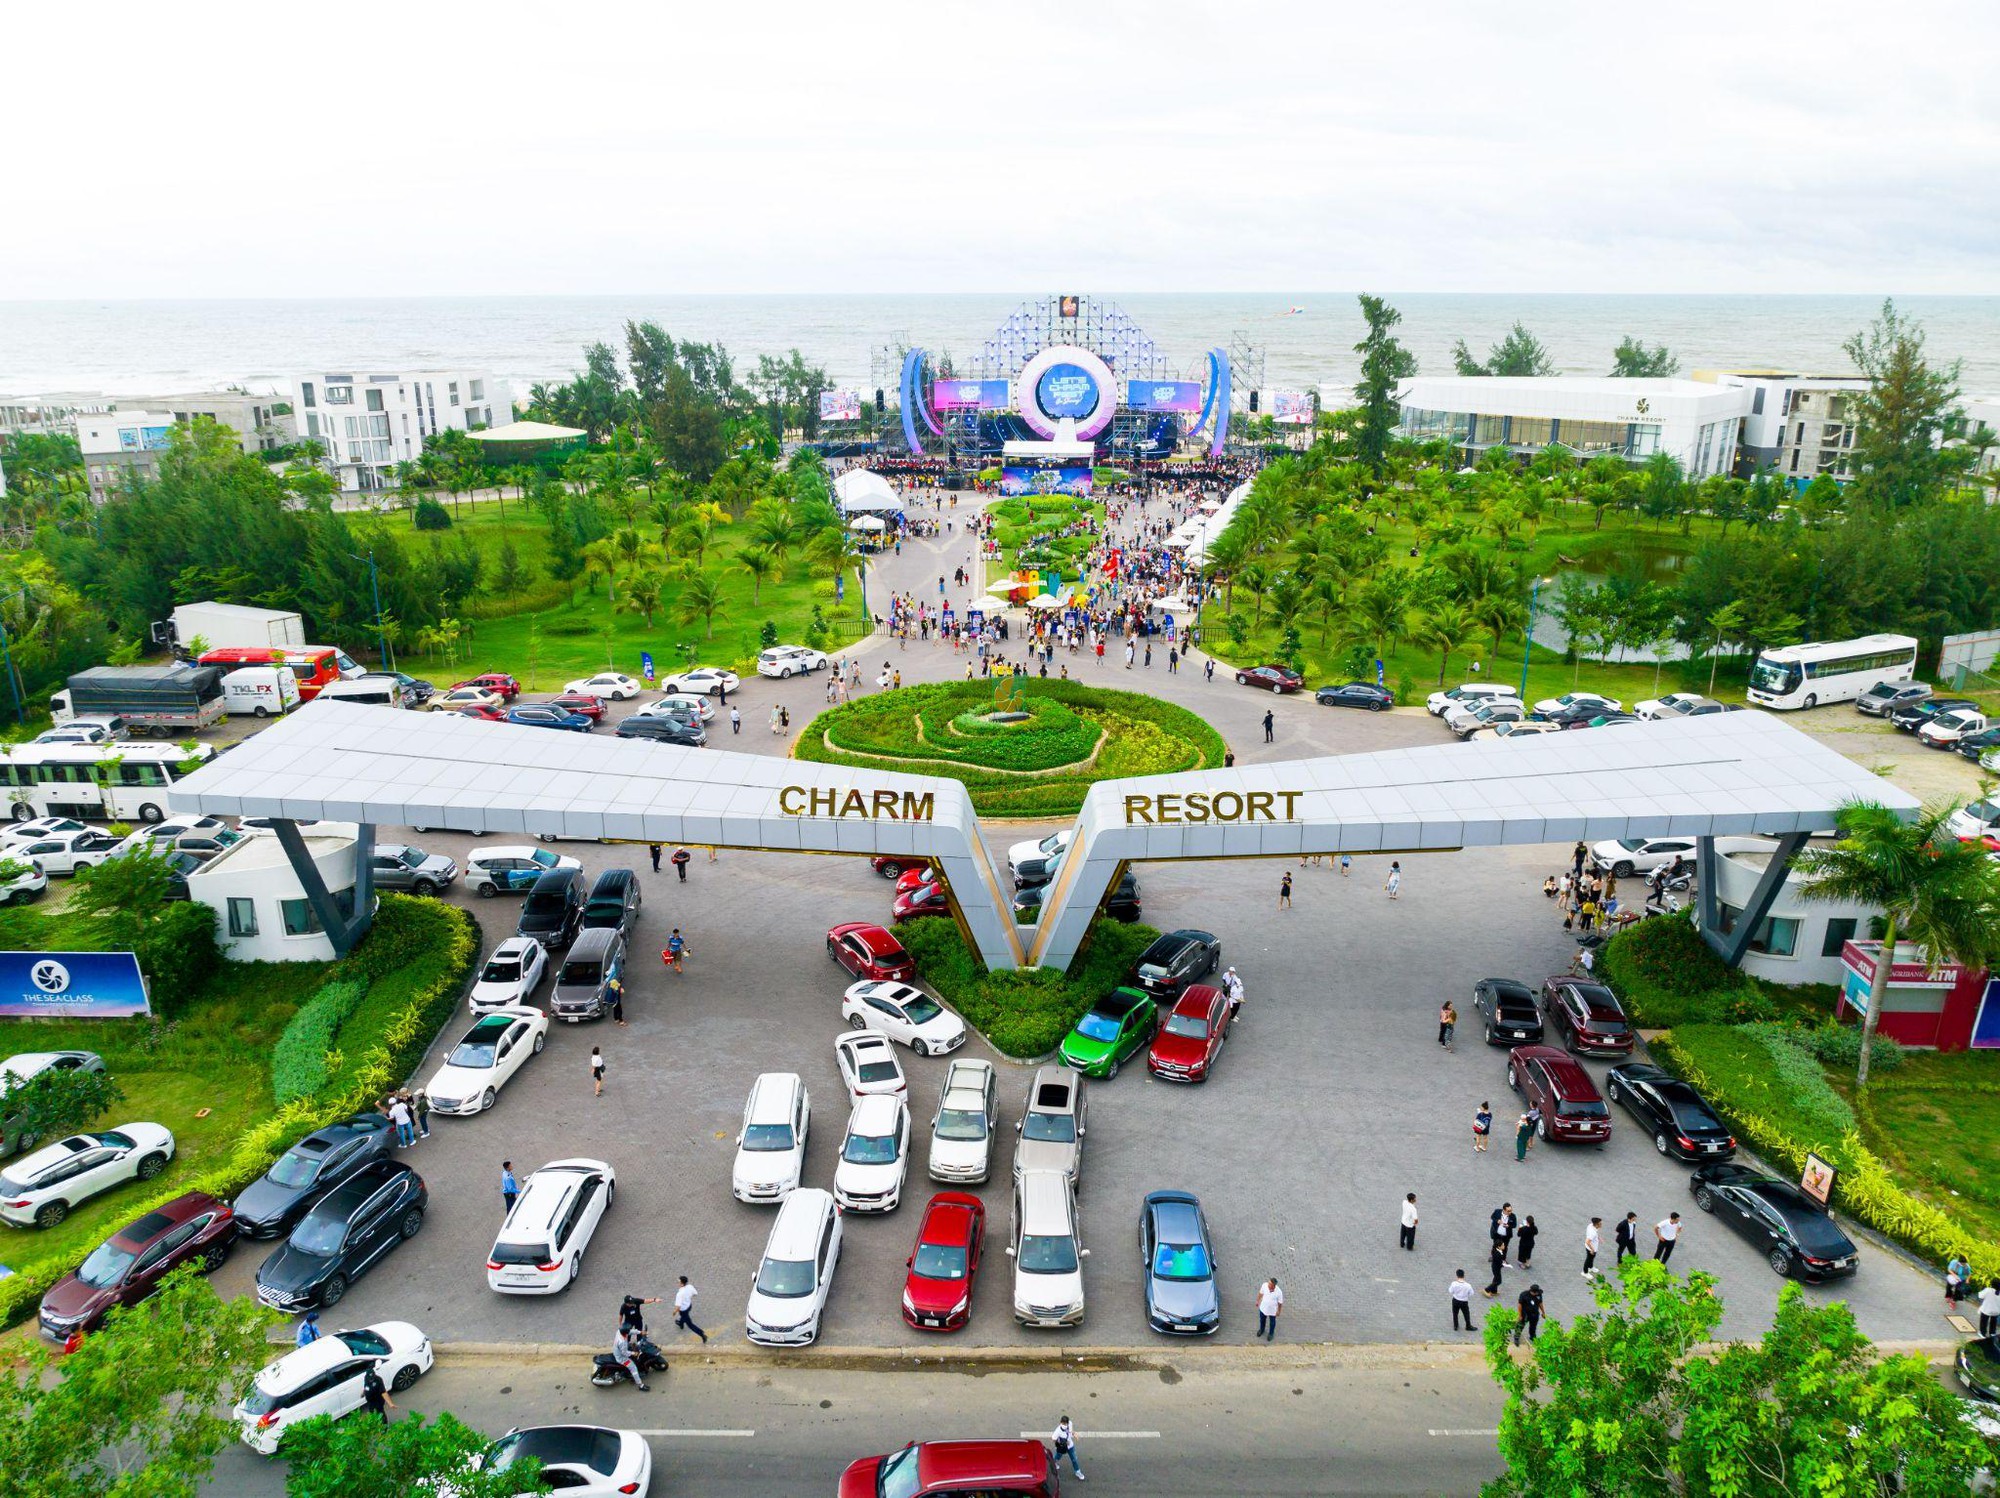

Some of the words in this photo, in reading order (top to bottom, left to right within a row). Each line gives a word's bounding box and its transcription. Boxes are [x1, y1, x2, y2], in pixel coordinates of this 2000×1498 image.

[232, 685, 255, 693] TKL
[779, 785, 934, 821] CHARM
[1125, 790, 1303, 823] RESORT
[1857, 960, 1873, 978] ATM
[1891, 969, 1925, 979] AGRIBANK
[1927, 970, 1958, 982] ATM
[23, 994, 42, 1002] THE
[44, 994, 63, 1002] SEA
[63, 994, 94, 1003] CLASS
